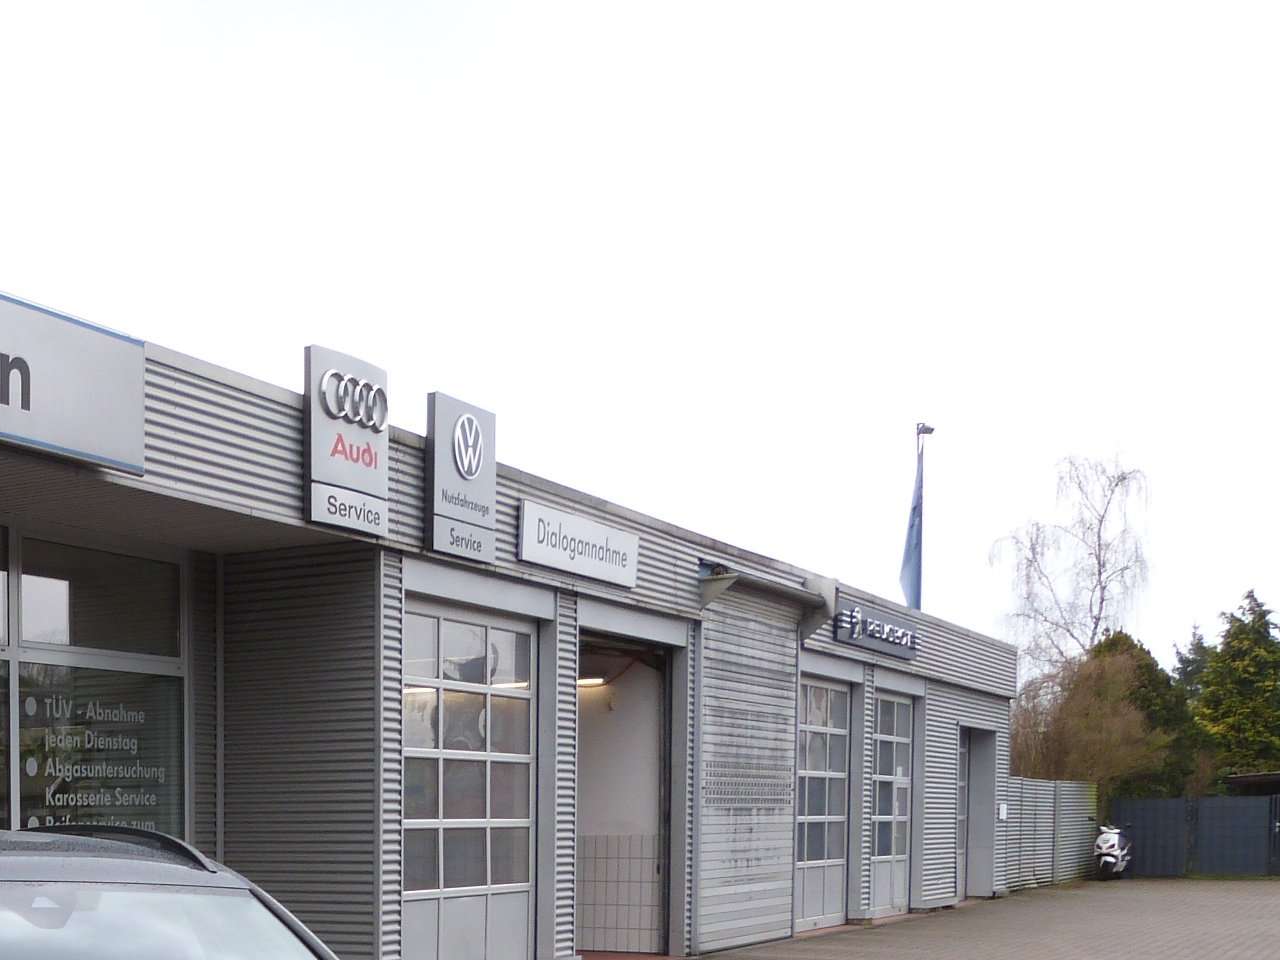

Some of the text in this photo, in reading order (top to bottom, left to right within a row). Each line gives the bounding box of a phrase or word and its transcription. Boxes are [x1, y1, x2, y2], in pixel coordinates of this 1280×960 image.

[330, 432, 378, 470] Audi
[327, 495, 381, 526] Service
[449, 527, 482, 553] Service
[537, 518, 628, 568] Dialogannahme
[45, 695, 72, 718] TÜV
[86, 701, 145, 723] Abnahme
[45, 728, 138, 754] jeden Dienstag
[44, 757, 166, 783] Abgasuntersuchung
[45, 786, 158, 806] Karosserie Service
